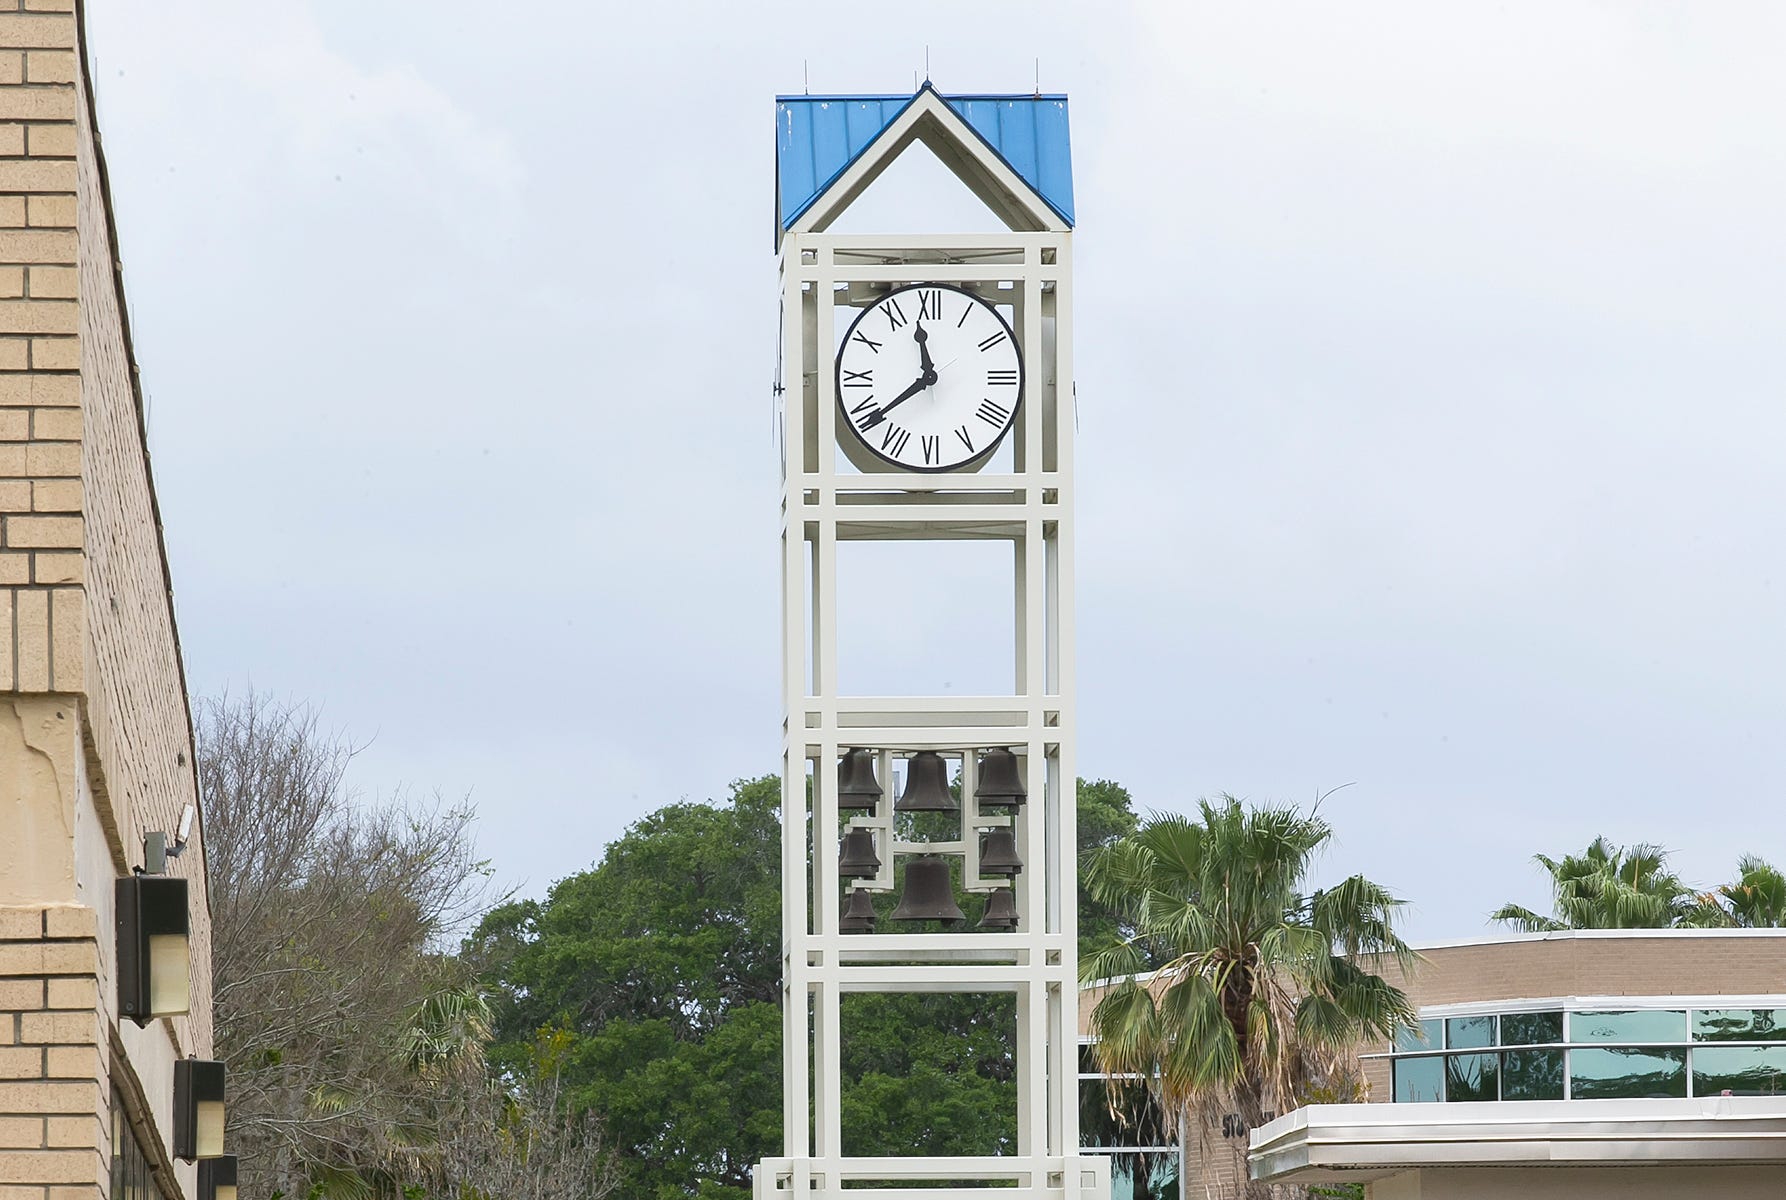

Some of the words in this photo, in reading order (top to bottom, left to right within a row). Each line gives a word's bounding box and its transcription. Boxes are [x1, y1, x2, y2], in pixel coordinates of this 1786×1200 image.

[878, 298, 908, 332] XI
[917, 290, 941, 320] XII
[852, 330, 882, 354] X
[978, 330, 1007, 352] II
[843, 369, 873, 387] IX
[987, 370, 1017, 385] III
[850, 394, 887, 433] VII
[975, 398, 1010, 429] IIII
[881, 422, 911, 458] VII
[921, 435, 939, 465] VI
[954, 425, 974, 453] V
